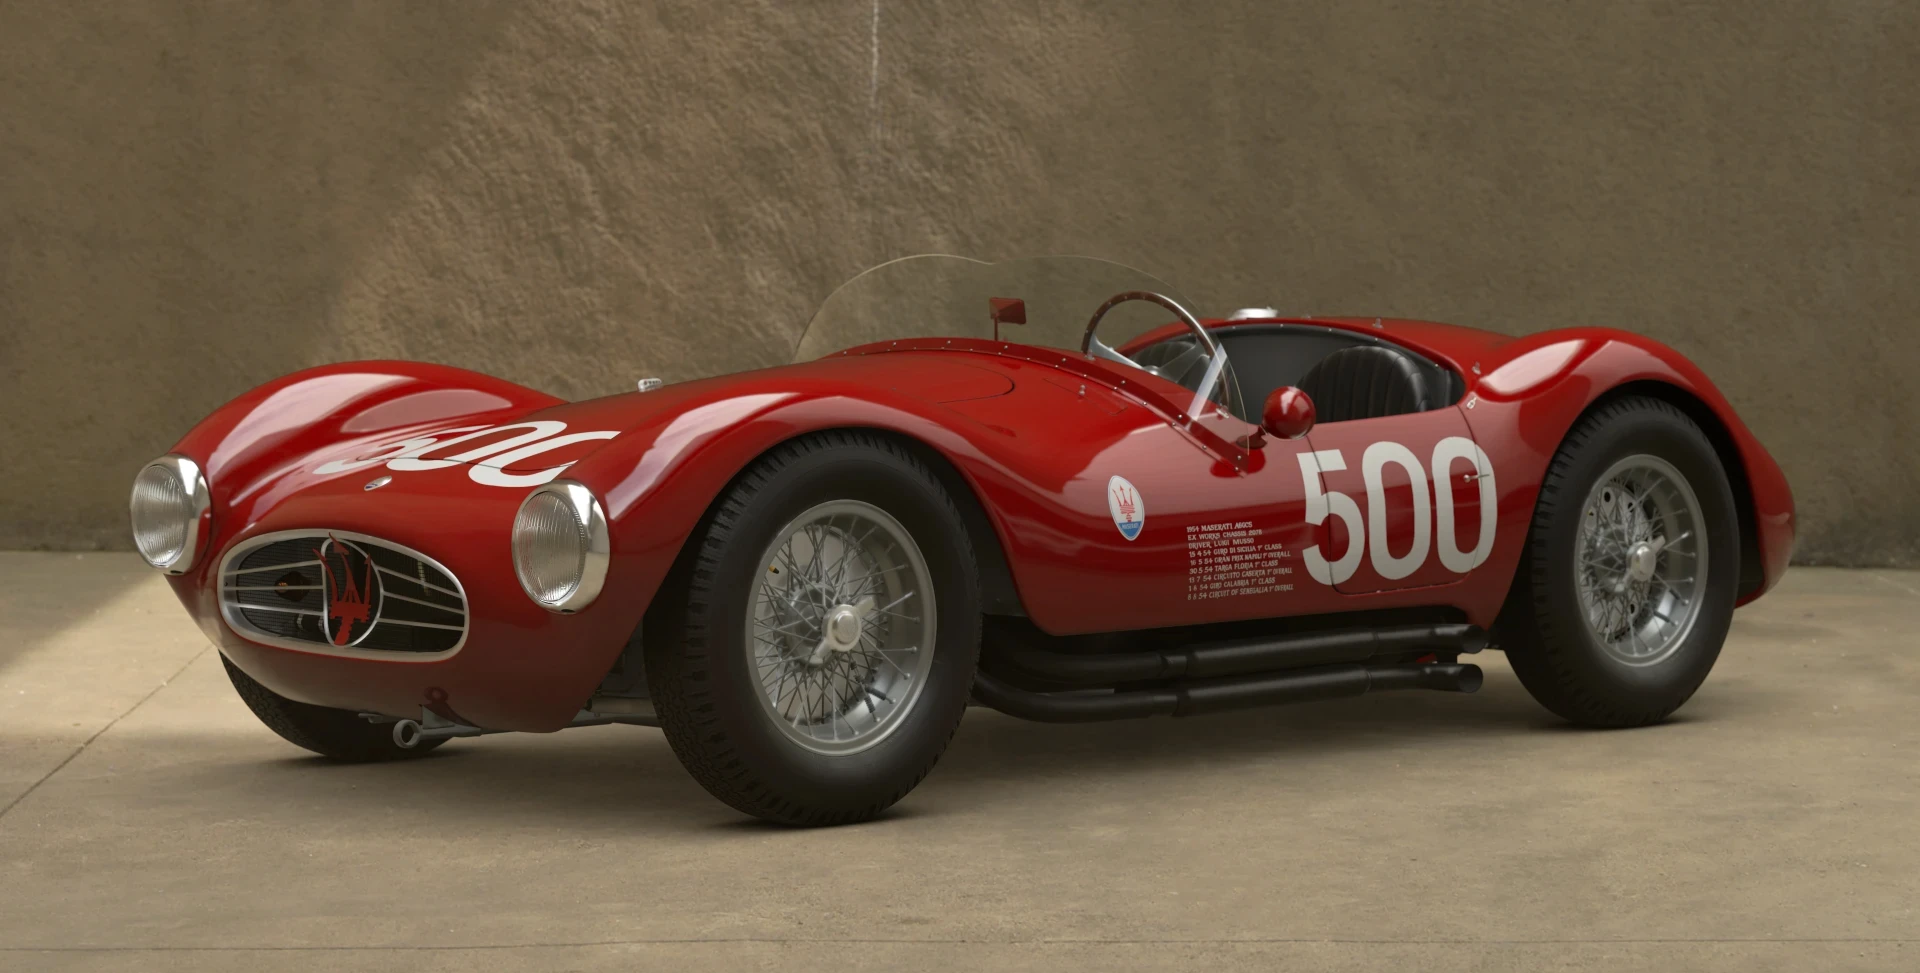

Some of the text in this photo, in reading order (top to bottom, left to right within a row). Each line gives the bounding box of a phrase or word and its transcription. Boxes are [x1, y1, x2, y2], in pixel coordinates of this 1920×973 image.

[1296, 436, 1498, 586] 500
[1201, 522, 1233, 531] MASERATI
[1188, 541, 1212, 550] DRIVER
[1213, 548, 1228, 556] GIRO
[1268, 550, 1291, 559] OVERALL
[1215, 564, 1232, 572] TARGA
[1214, 572, 1240, 581] CIRCUITO
[1224, 579, 1249, 587] CALABRIA
[1209, 590, 1230, 599] CIRCUIT
[1275, 584, 1294, 592] OVERALL
